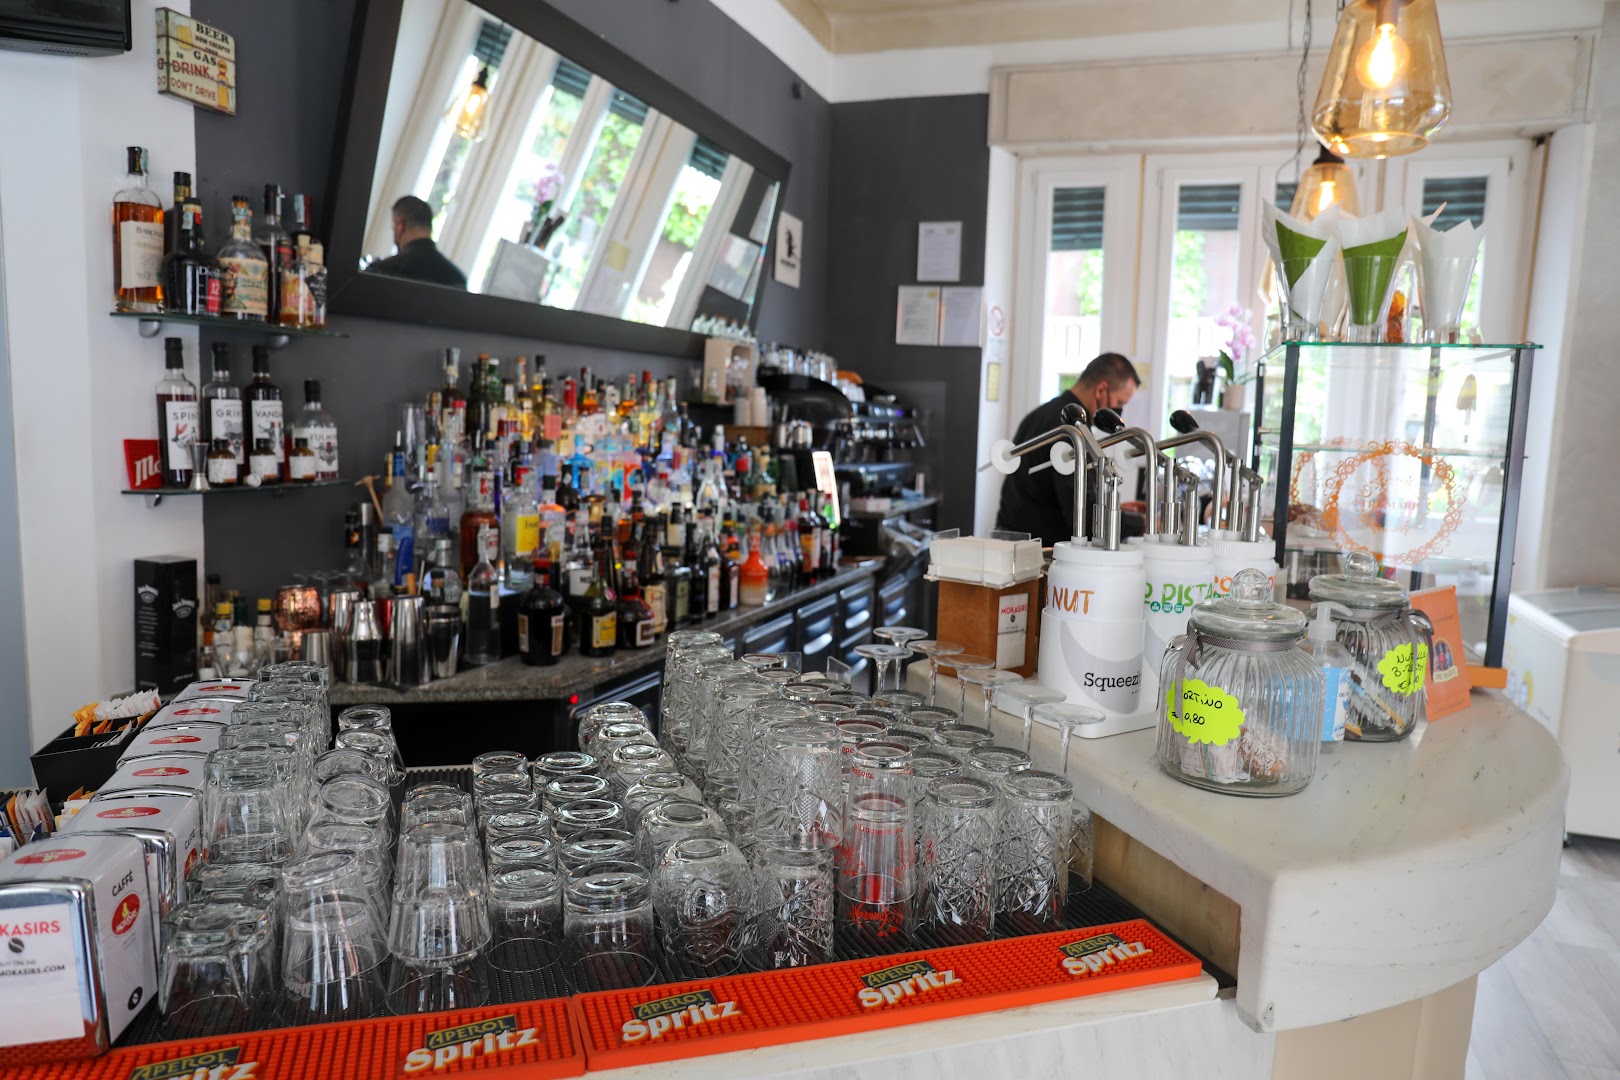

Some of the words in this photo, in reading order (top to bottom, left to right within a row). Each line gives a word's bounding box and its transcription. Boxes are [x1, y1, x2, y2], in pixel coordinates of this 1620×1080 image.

[196, 23, 230, 45] BEER
[193, 50, 217, 66] GAS
[171, 77, 193, 93] DON'T
[195, 86, 217, 101] DRIVE
[215, 408, 242, 418] GRIN
[1052, 585, 1095, 615] NUT
[1183, 690, 1223, 709] ORTINO
[112, 868, 134, 897] CAFFÈ
[0, 920, 61, 937] KASIRS
[1062, 941, 1153, 975] Spritz
[868, 963, 929, 986] APEROL
[858, 970, 963, 1008] Spritz
[638, 993, 710, 1017] APEROL
[429, 1020, 505, 1045] APEROL
[622, 1001, 741, 1042] Spritz
[404, 1027, 539, 1073] Spritz
[131, 1052, 229, 1080] APEROL
